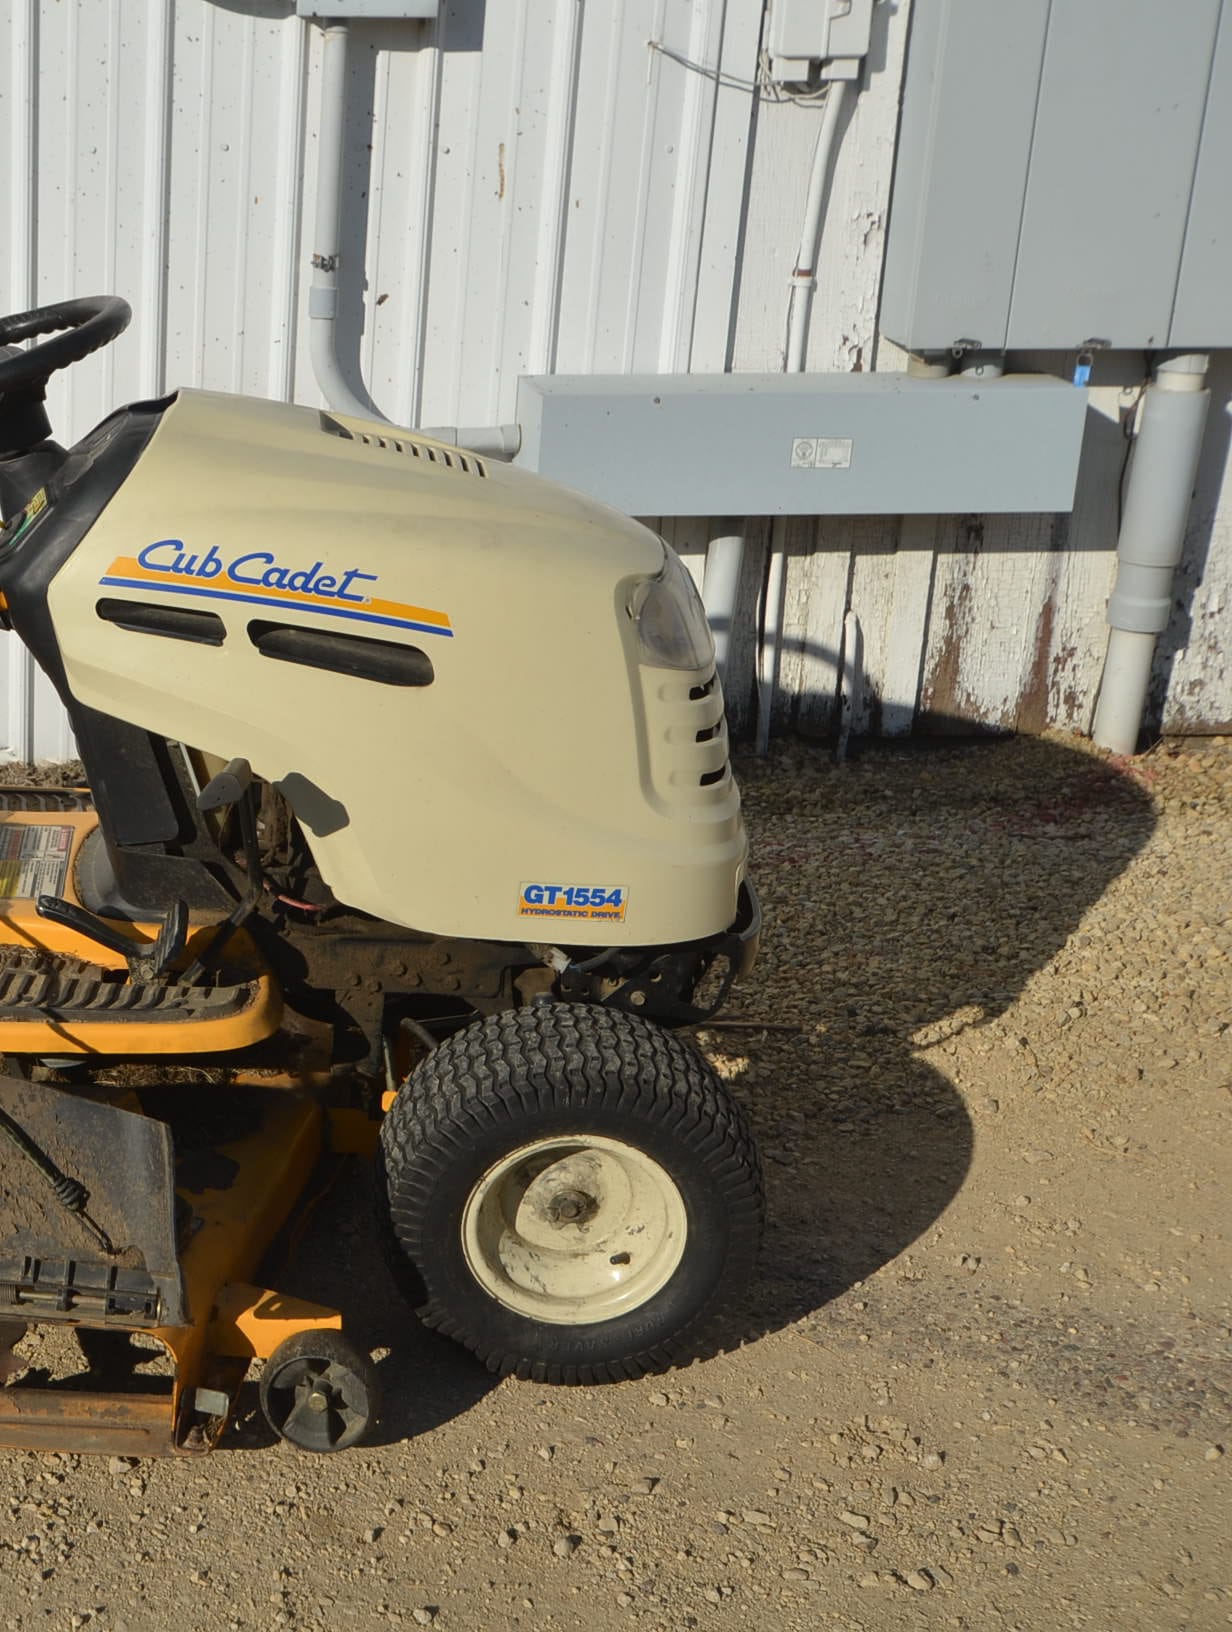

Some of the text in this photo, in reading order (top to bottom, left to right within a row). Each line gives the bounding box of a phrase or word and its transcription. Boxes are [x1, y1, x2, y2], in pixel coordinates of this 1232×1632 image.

[138, 539, 378, 602] Cub Cadet
[523, 884, 623, 908] GT1554
[520, 907, 589, 918] HYDROSTATIC
